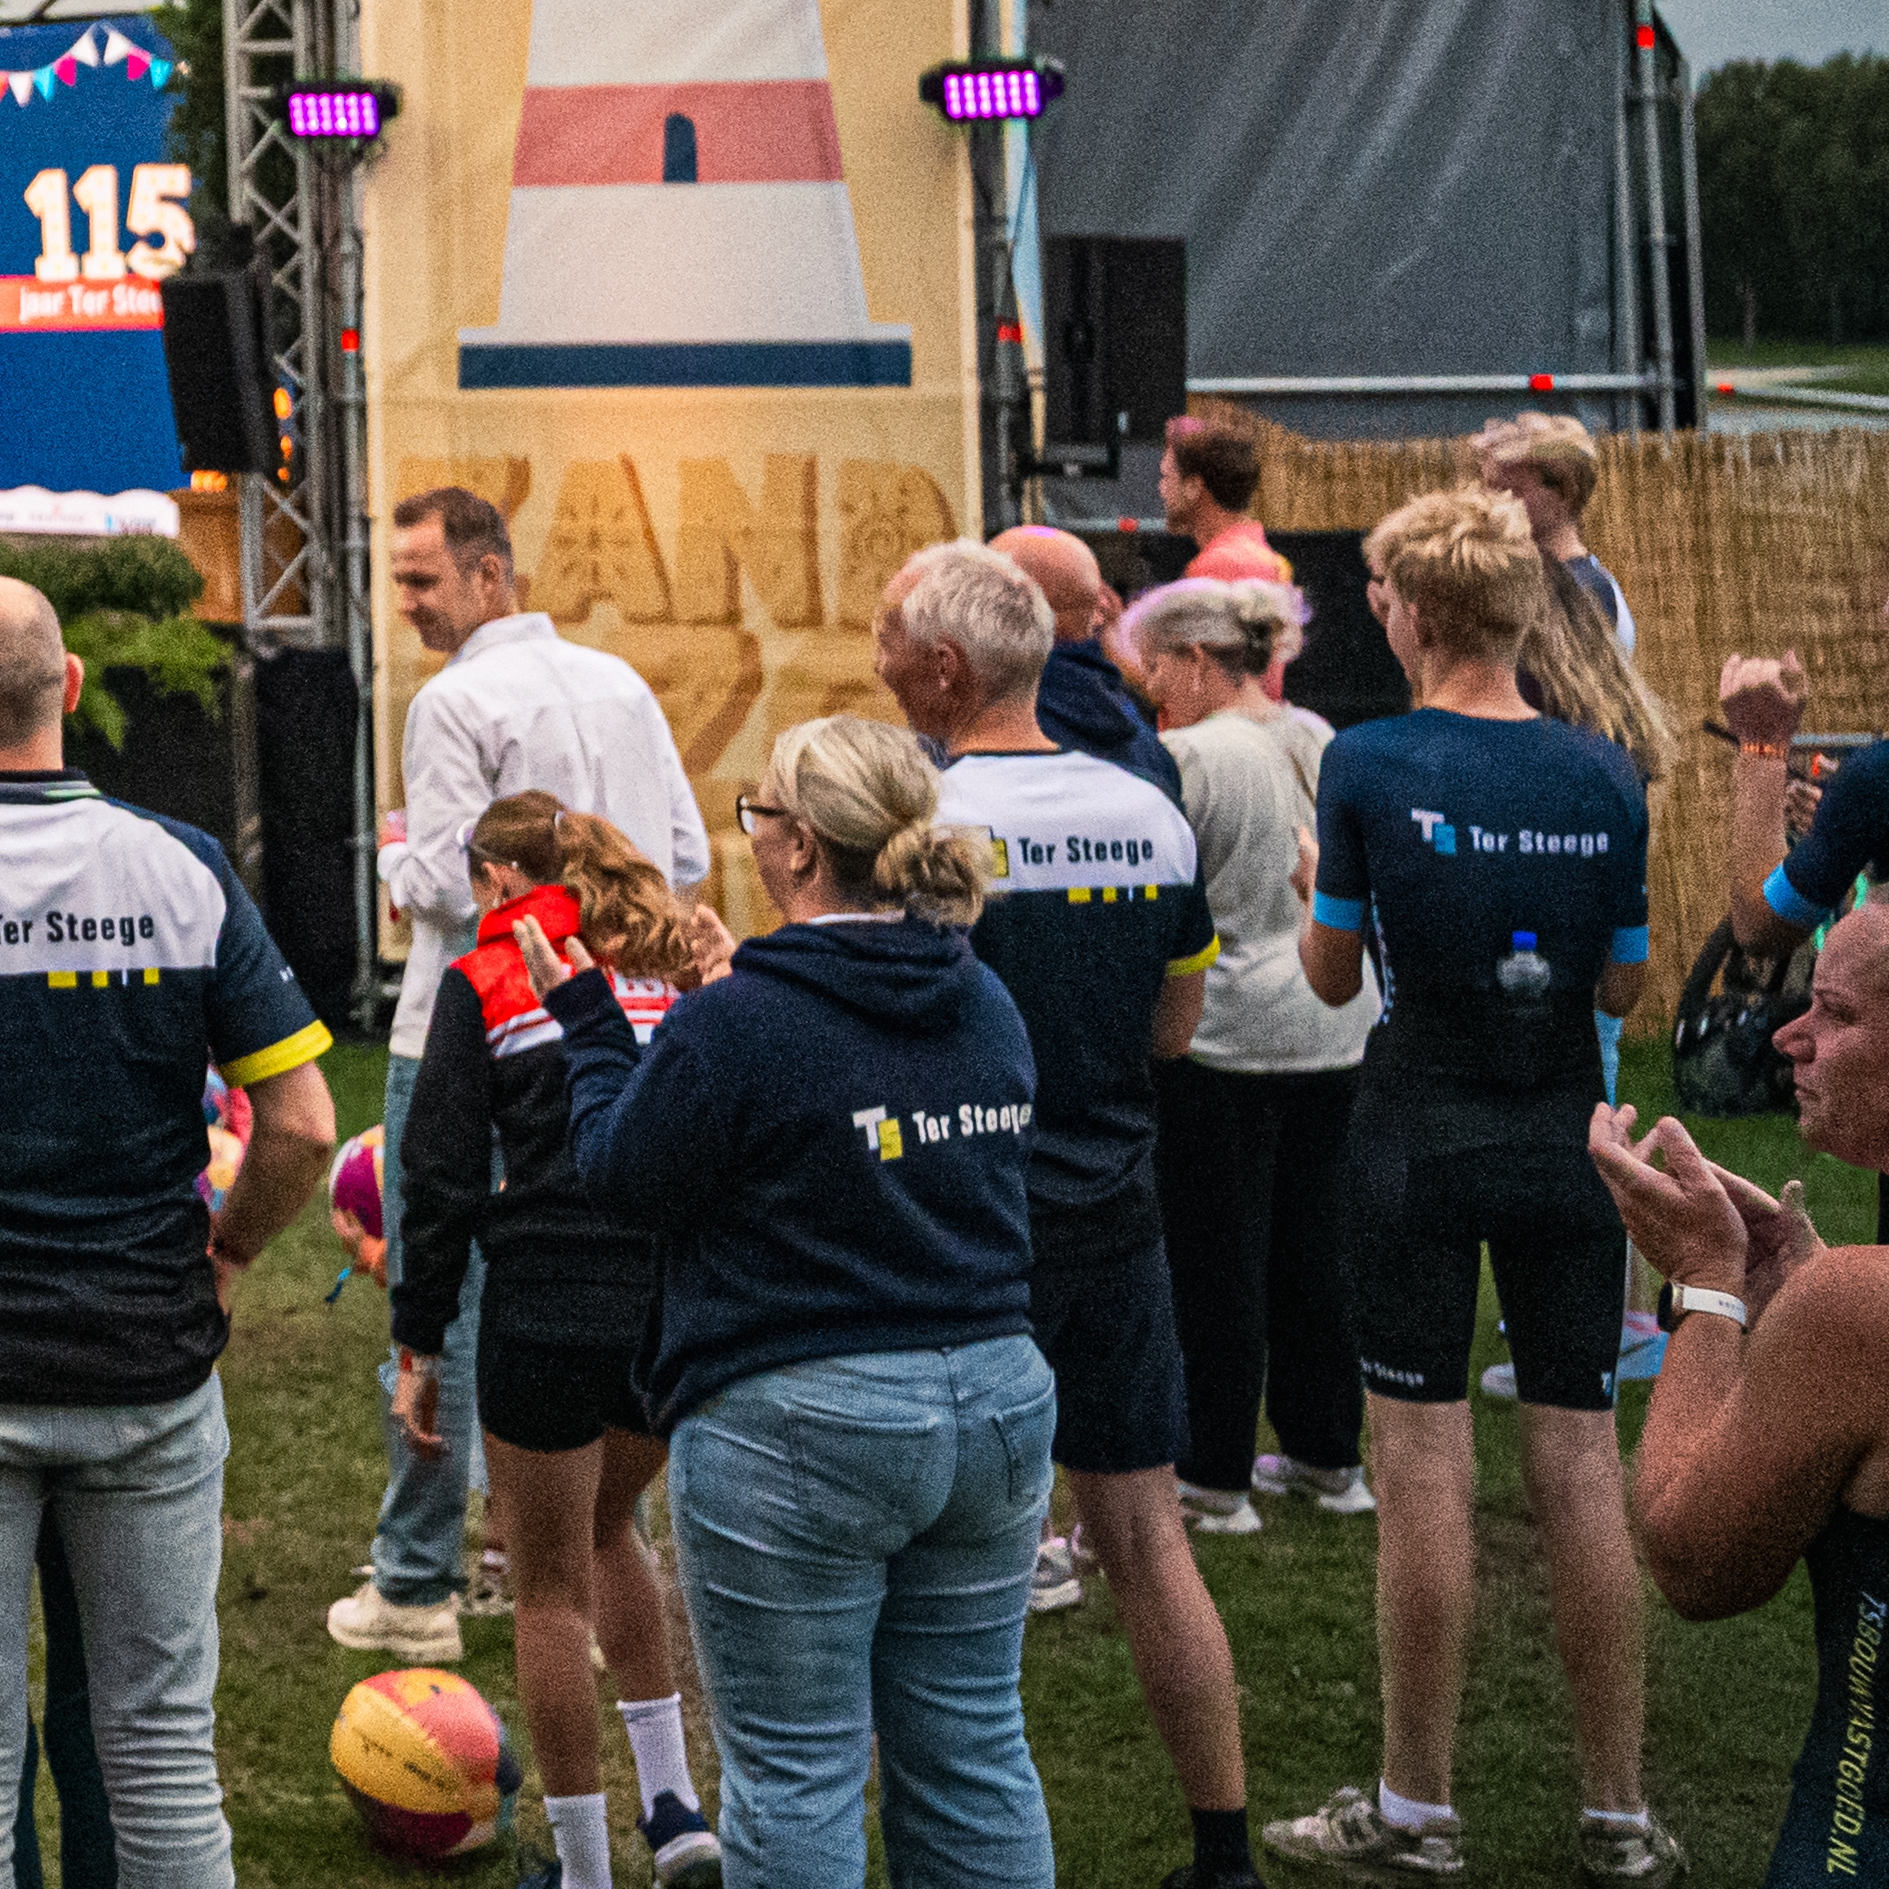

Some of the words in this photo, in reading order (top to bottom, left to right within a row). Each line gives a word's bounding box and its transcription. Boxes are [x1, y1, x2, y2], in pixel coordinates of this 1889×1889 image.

[23, 163, 196, 281] 115
[67, 284, 109, 316] Ter
[1017, 836, 1056, 864] Ter
[1066, 835, 1153, 867] Steege
[1468, 824, 1508, 852] Ter
[1519, 828, 1609, 858] Steege
[46, 910, 155, 947] Steege
[912, 1110, 950, 1144] Ter
